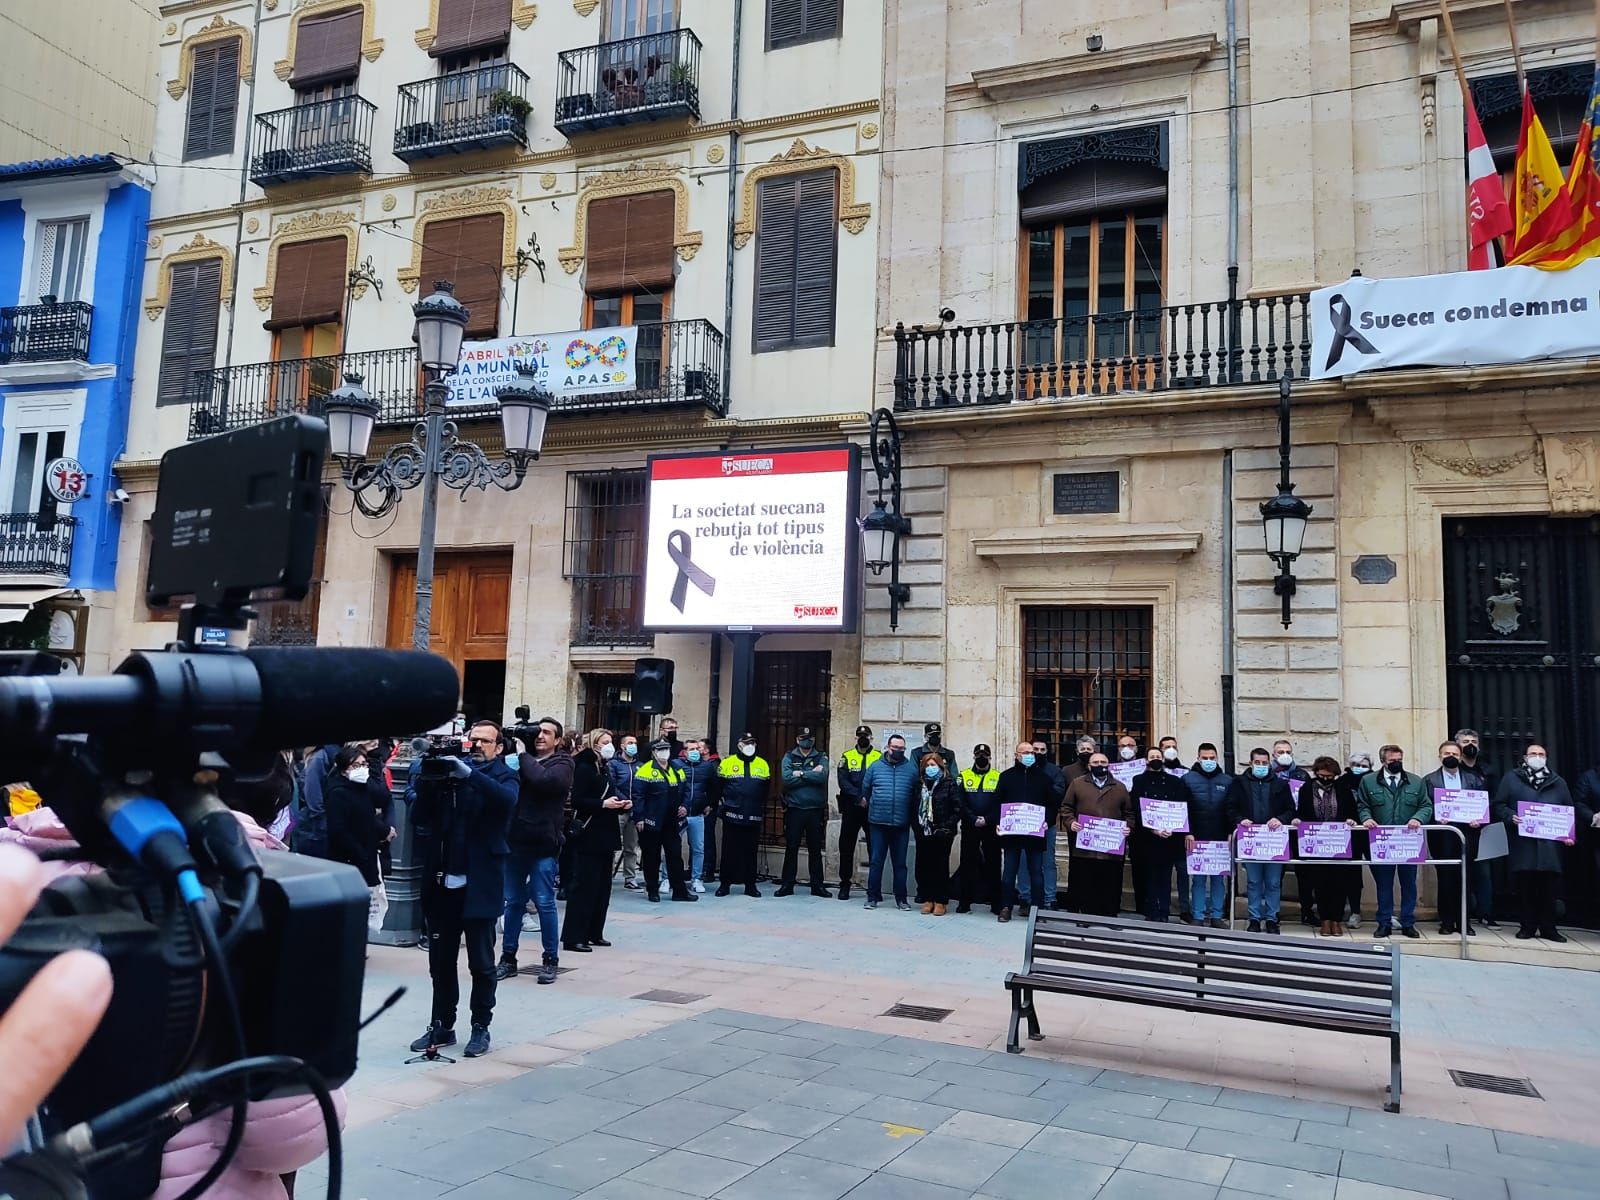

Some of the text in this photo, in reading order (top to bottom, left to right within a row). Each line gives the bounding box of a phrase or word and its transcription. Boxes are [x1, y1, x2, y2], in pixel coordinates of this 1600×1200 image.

[1360, 297, 1587, 330] Sueca condemna
[456, 356, 549, 376] IA MUNDAL
[563, 372, 610, 386] APAS
[447, 389, 464, 401] DE
[733, 459, 772, 472] SUECA
[58, 471, 81, 493] 13
[672, 502, 825, 518] La societat suecana
[695, 519, 825, 539] rebutja tot tipus
[730, 539, 824, 556] de violència
[803, 606, 838, 617] SUECA
